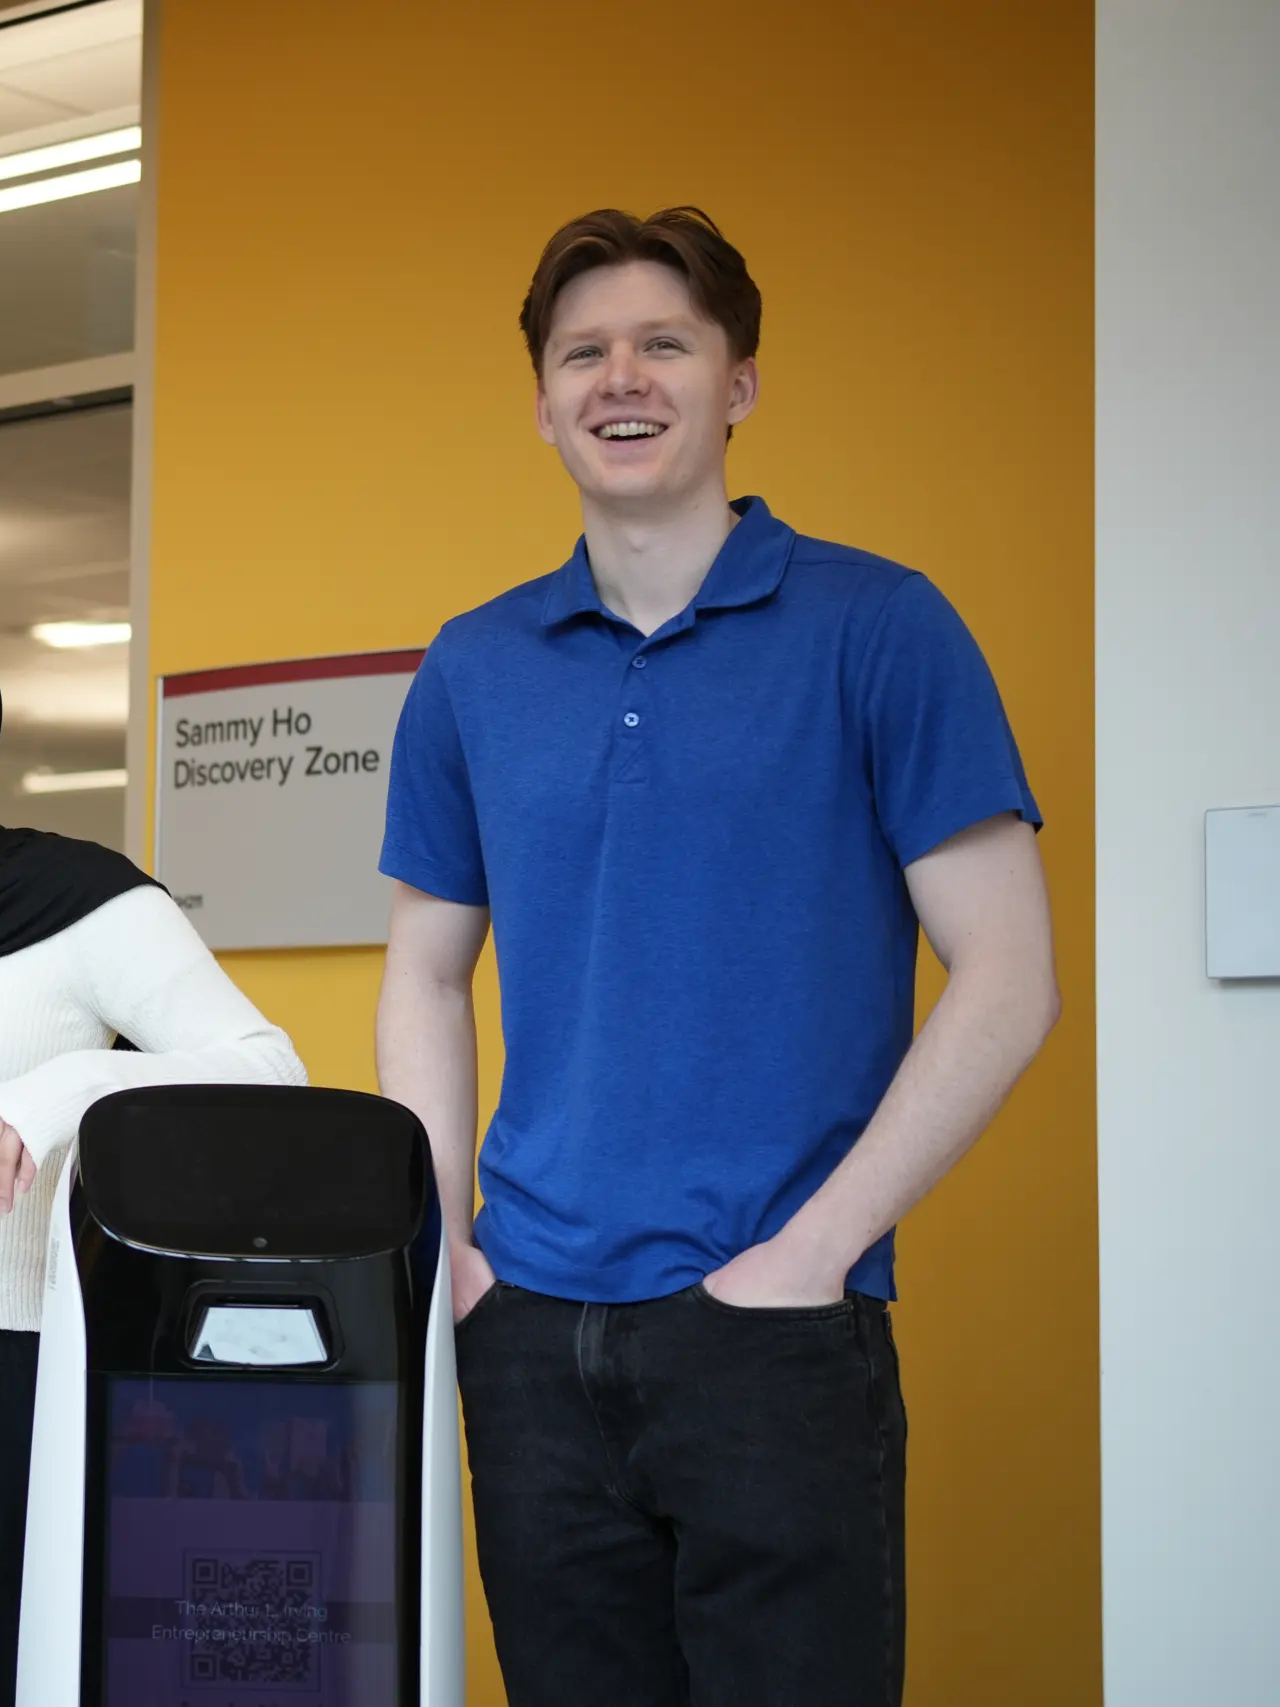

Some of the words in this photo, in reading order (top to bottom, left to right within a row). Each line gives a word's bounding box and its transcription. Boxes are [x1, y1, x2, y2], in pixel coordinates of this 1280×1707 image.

[175, 717, 264, 748] Sammy
[272, 707, 312, 737] Ho
[173, 755, 294, 789] Discovery
[304, 746, 380, 777] Zone
[176, 1601, 206, 1616] The
[152, 1625, 292, 1645] Entrepreneurship
[297, 1628, 352, 1644] Centre
